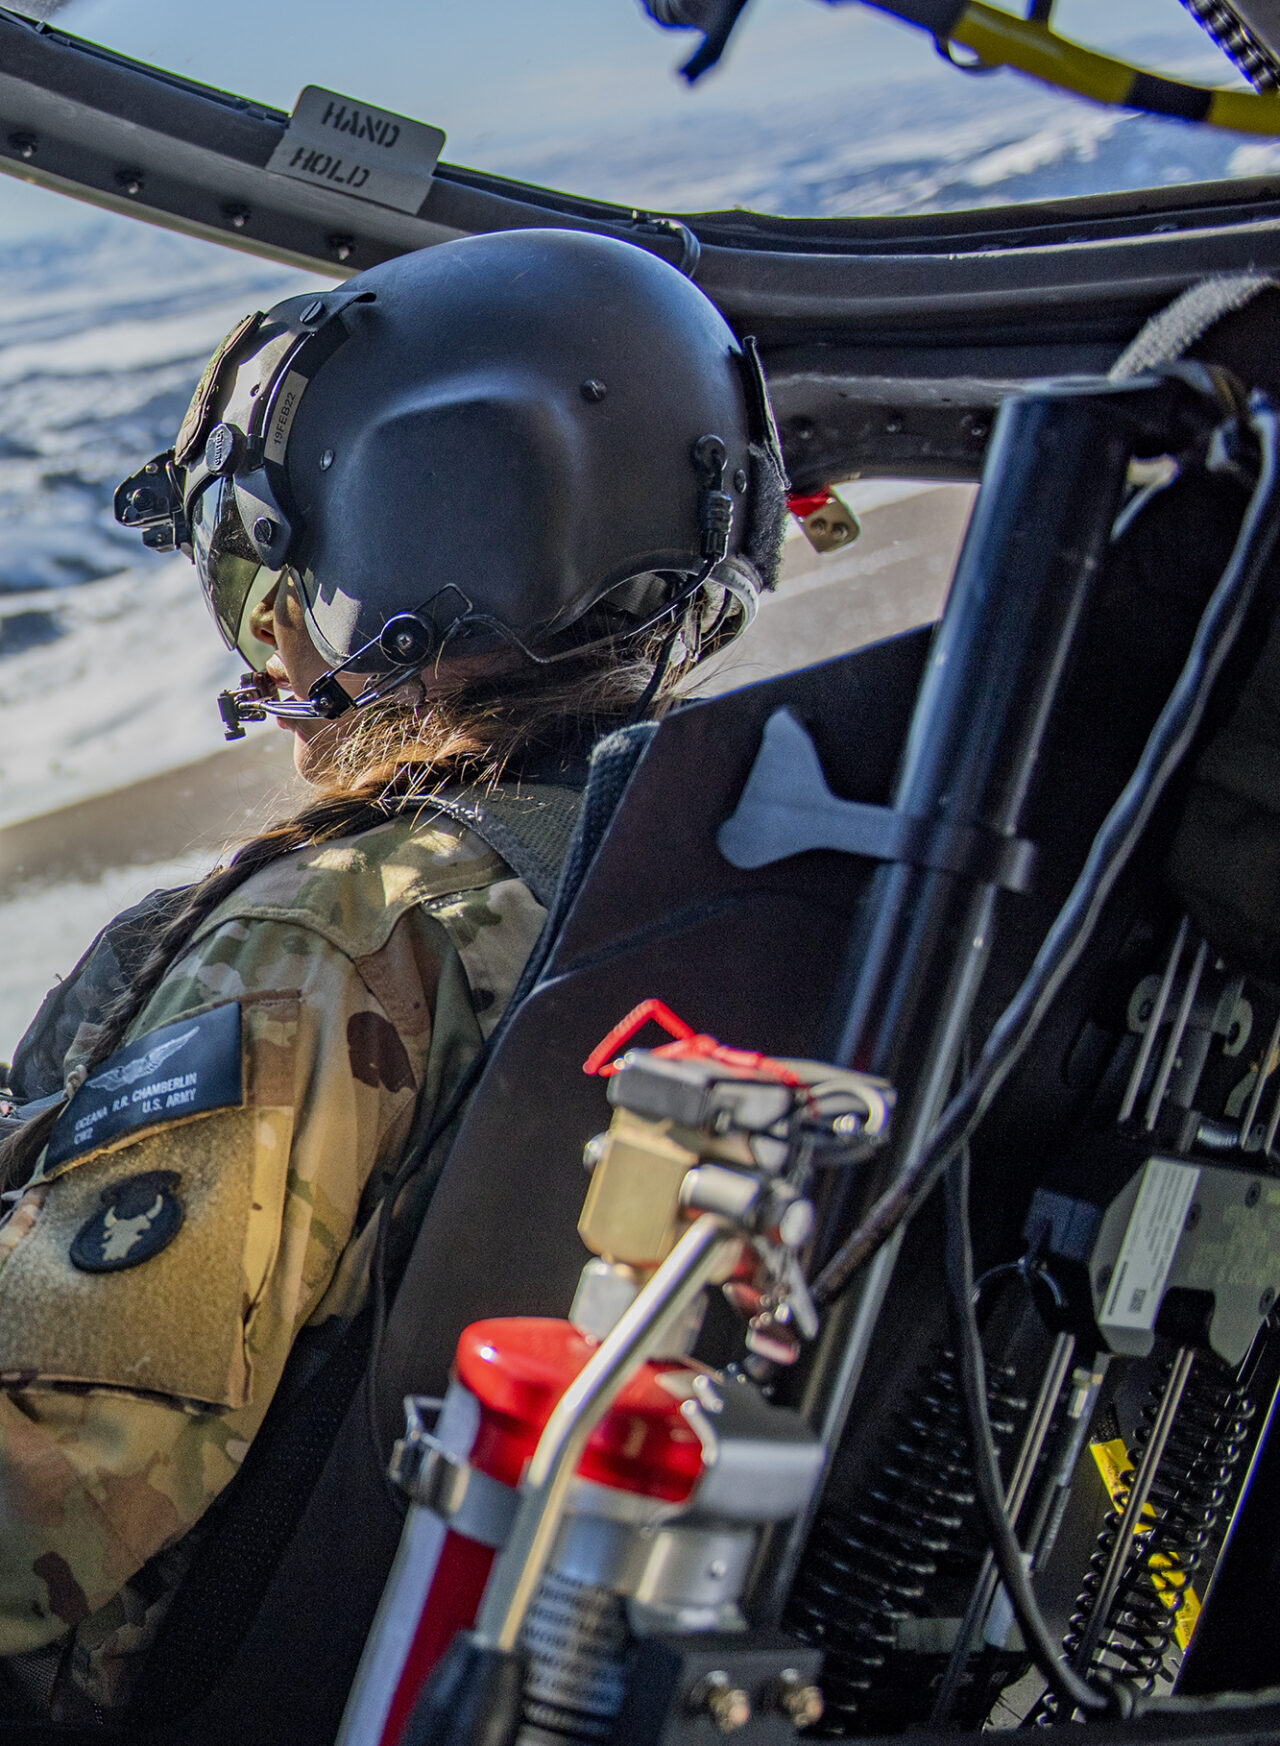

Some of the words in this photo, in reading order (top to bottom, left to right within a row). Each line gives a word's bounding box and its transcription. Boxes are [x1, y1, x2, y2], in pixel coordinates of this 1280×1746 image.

[321, 101, 400, 148] HAND
[289, 147, 370, 188] HOLD
[274, 391, 296, 446] 19FEB22
[74, 1106, 108, 1131] OCEANA
[112, 1093, 131, 1112] R.R.
[132, 1072, 198, 1103] CHAMBERLIN
[142, 1096, 162, 1114] U.S.
[166, 1088, 198, 1109] ARMY
[73, 1128, 94, 1145] CW2
